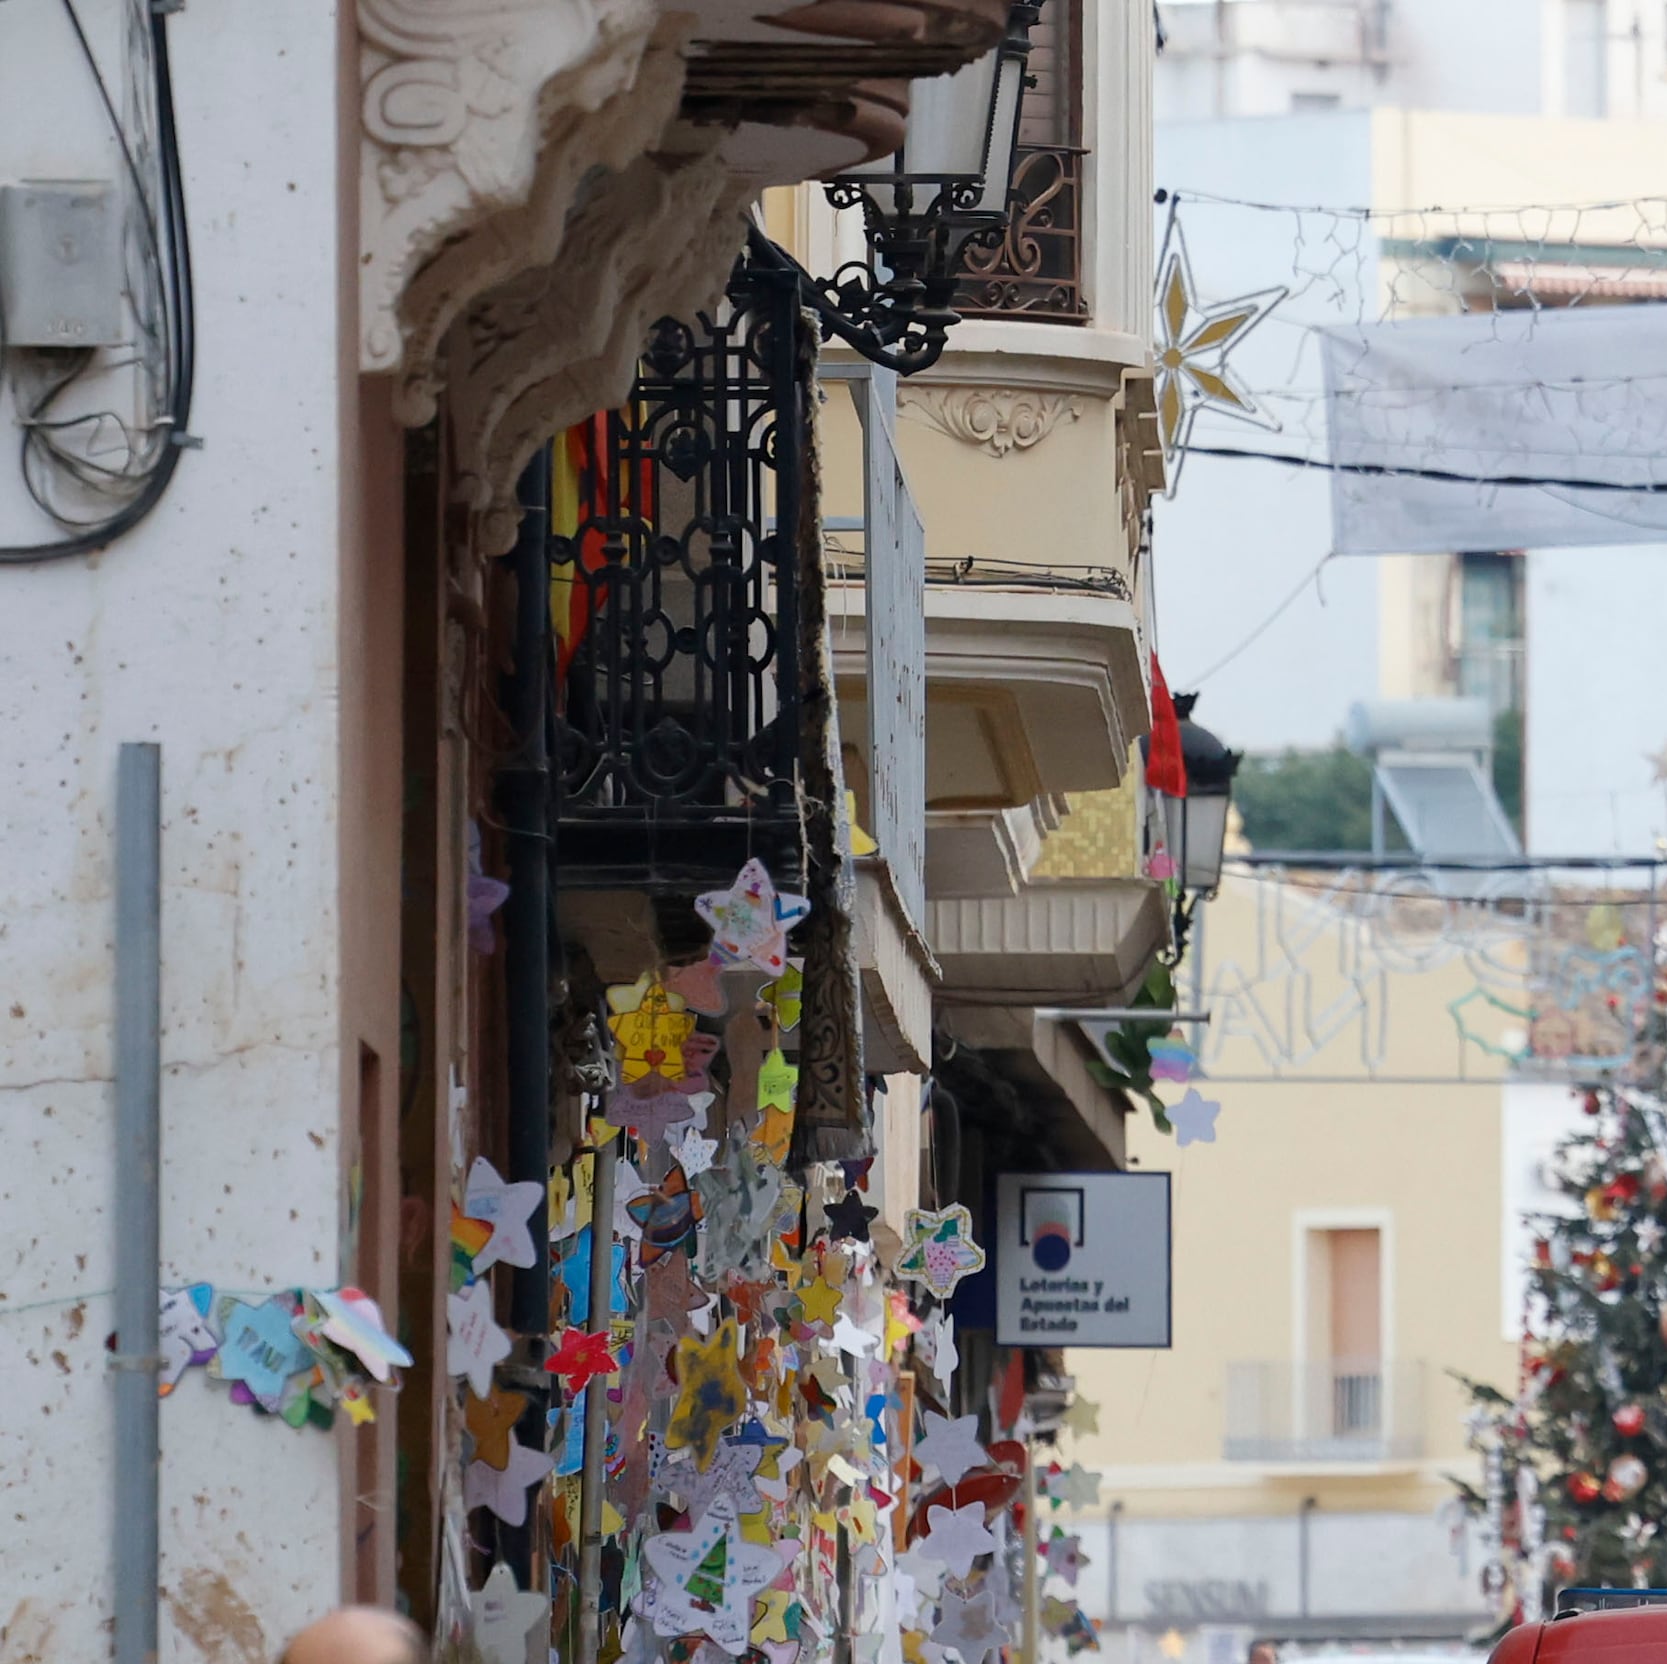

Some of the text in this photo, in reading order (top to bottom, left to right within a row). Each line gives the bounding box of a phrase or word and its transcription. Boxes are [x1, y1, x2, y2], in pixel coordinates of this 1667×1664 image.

[1094, 1281, 1104, 1297] y
[1020, 1296, 1129, 1314] Apuestas del
[1019, 1316, 1078, 1332] Estado
